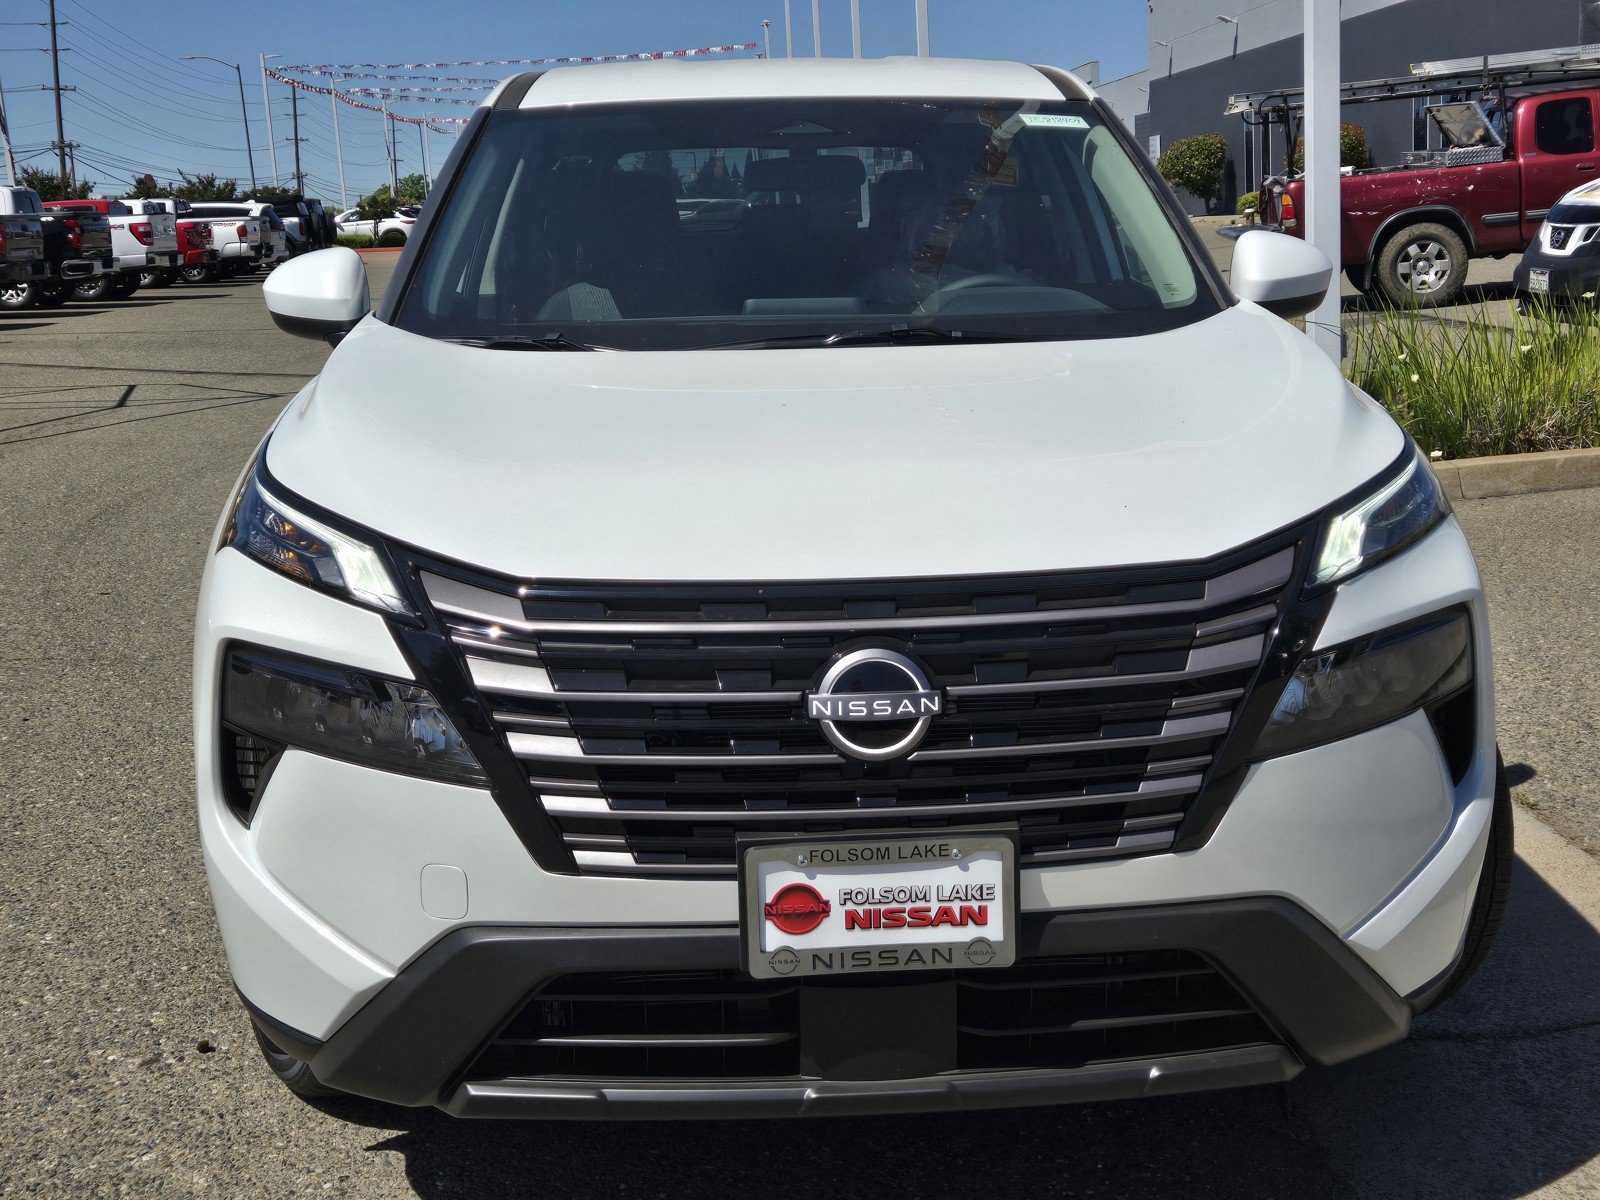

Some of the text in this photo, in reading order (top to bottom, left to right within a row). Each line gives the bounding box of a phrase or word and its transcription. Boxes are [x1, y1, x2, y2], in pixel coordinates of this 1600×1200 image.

[812, 696, 939, 716] NISSAN
[809, 843, 950, 863] FOLSOM LAKE
[839, 883, 996, 905] FOLSOM LAKE
[765, 902, 831, 915] NISSAN
[844, 904, 989, 930] NISSAN
[769, 958, 801, 966] NISSAN
[812, 947, 953, 970] NISSAN
